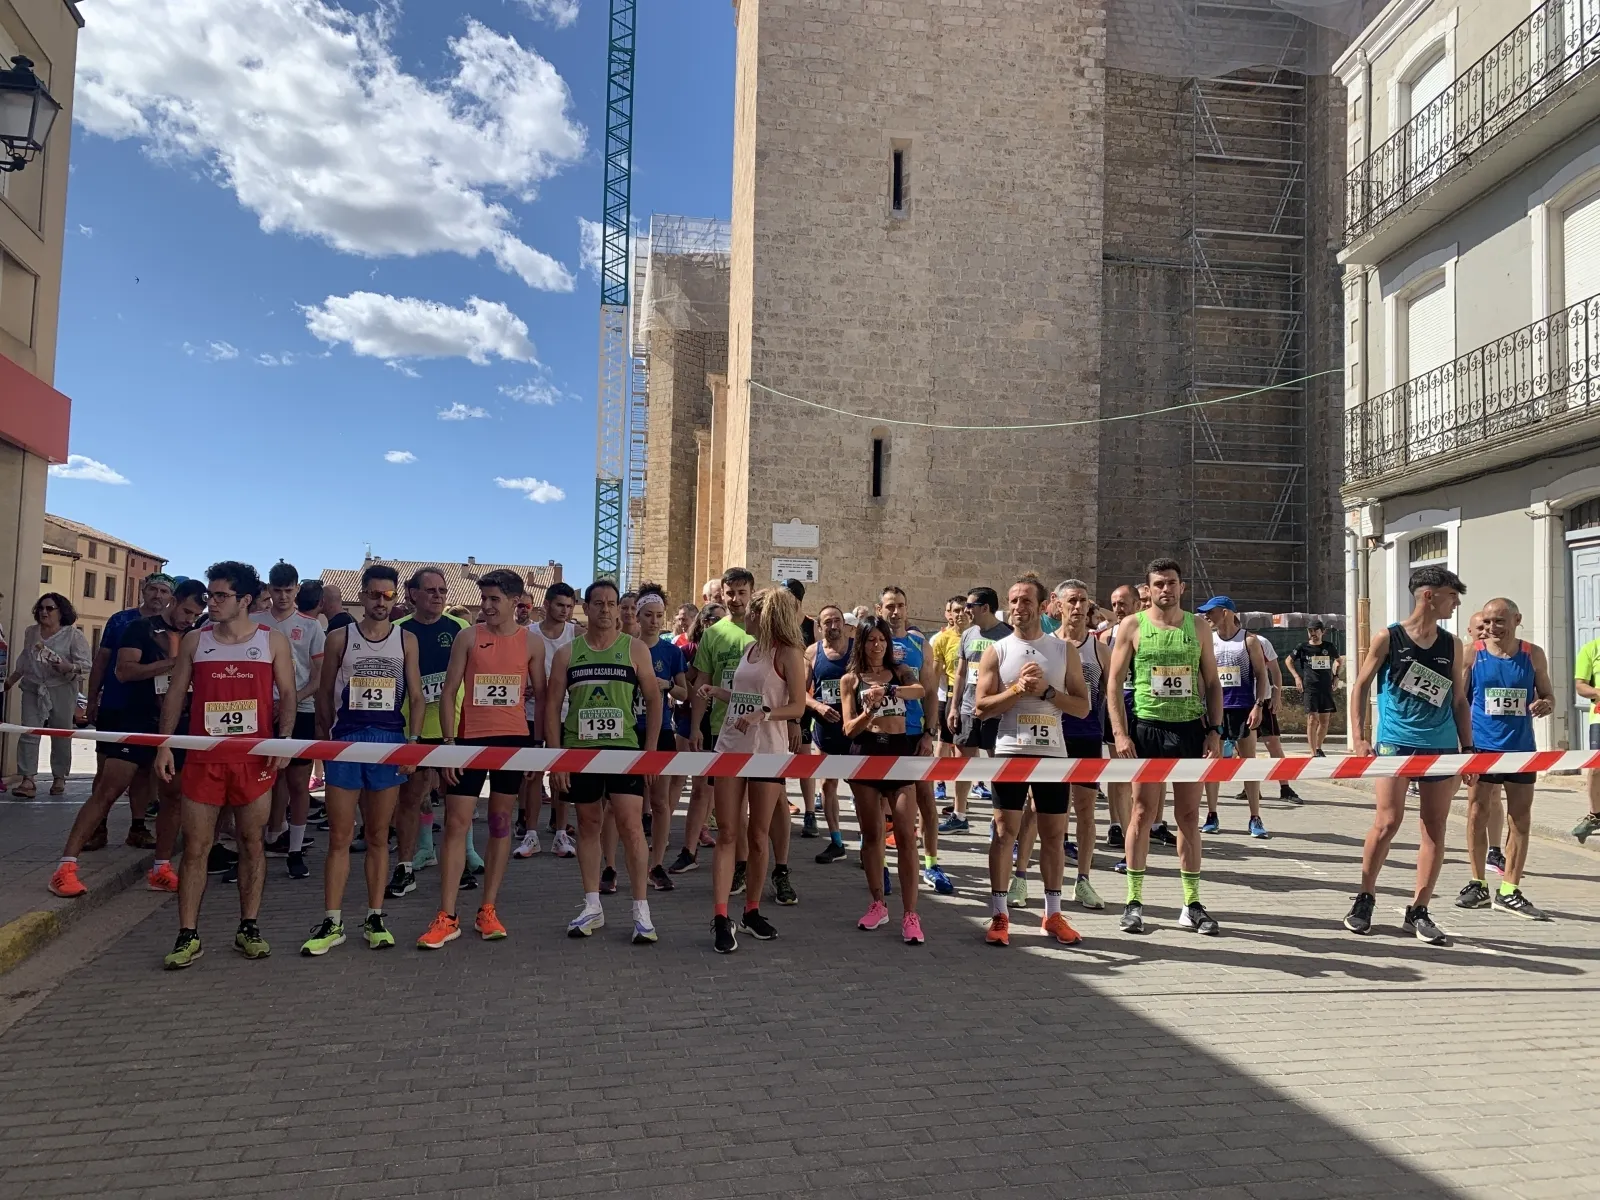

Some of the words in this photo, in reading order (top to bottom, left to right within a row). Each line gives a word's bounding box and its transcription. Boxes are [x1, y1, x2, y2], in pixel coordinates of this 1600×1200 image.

[571, 667, 593, 679] STADIUM
[594, 667, 627, 678] CASABLANCA
[1220, 673, 1232, 681] 40
[1163, 677, 1182, 688] 46
[1413, 676, 1440, 696] 125
[362, 688, 383, 701] 43
[487, 685, 507, 697] 23
[733, 703, 754, 715] 109
[1493, 698, 1519, 708] 151
[220, 712, 243, 724] 49
[587, 719, 615, 731] 139
[1030, 725, 1049, 737] 15
